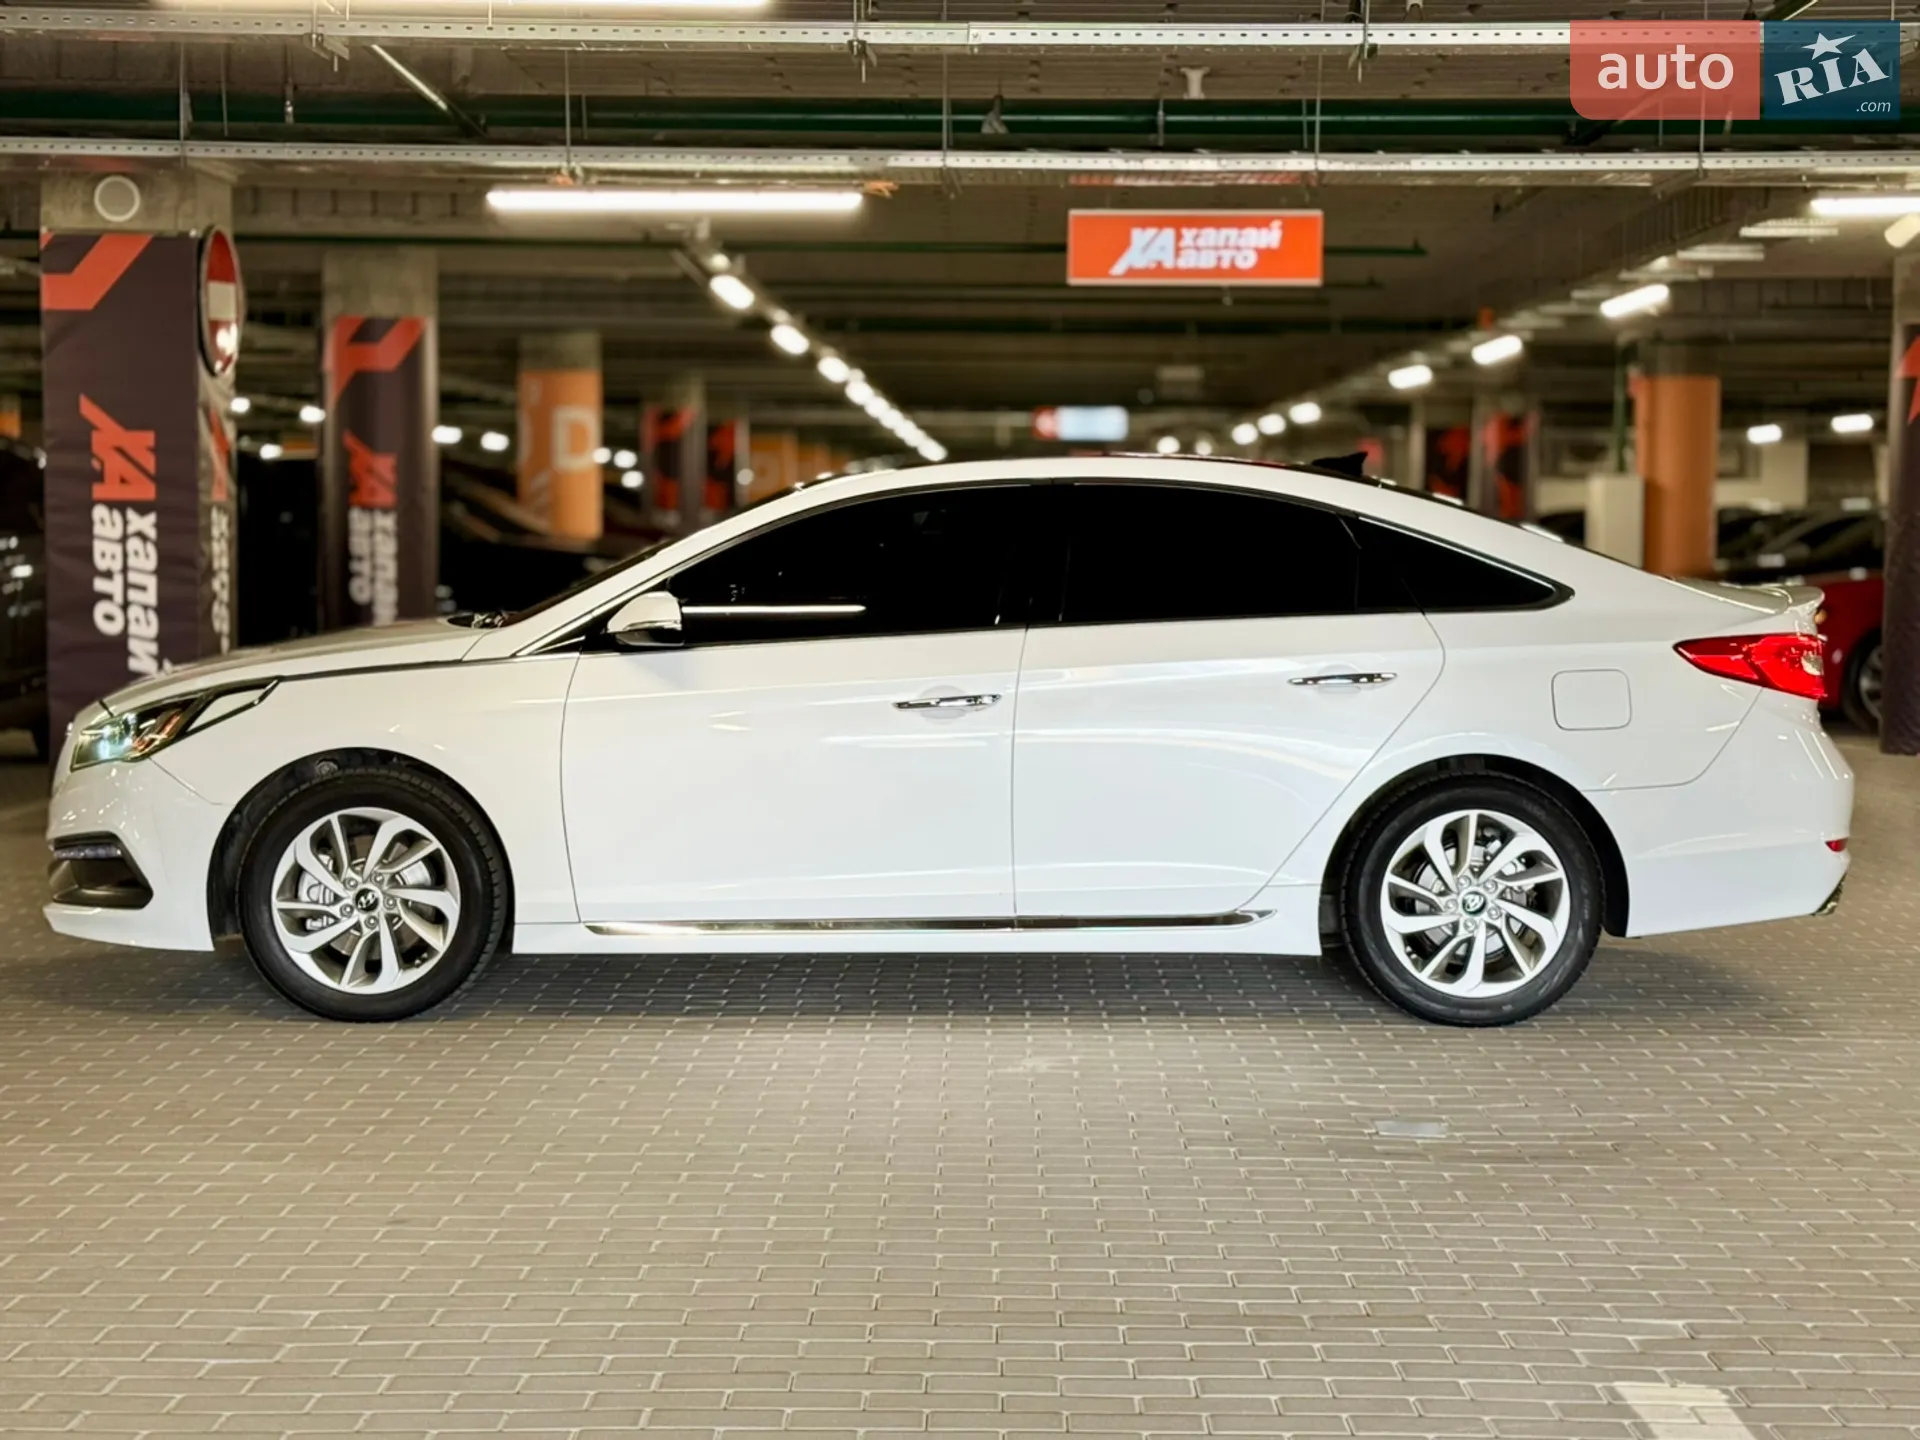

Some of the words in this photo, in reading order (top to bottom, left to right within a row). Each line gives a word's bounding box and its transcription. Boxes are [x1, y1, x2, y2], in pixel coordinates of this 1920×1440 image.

[1177, 249, 1258, 270] авто
[1178, 219, 1283, 249] хапай
[92, 503, 126, 637] авто
[126, 507, 172, 676] хапай
